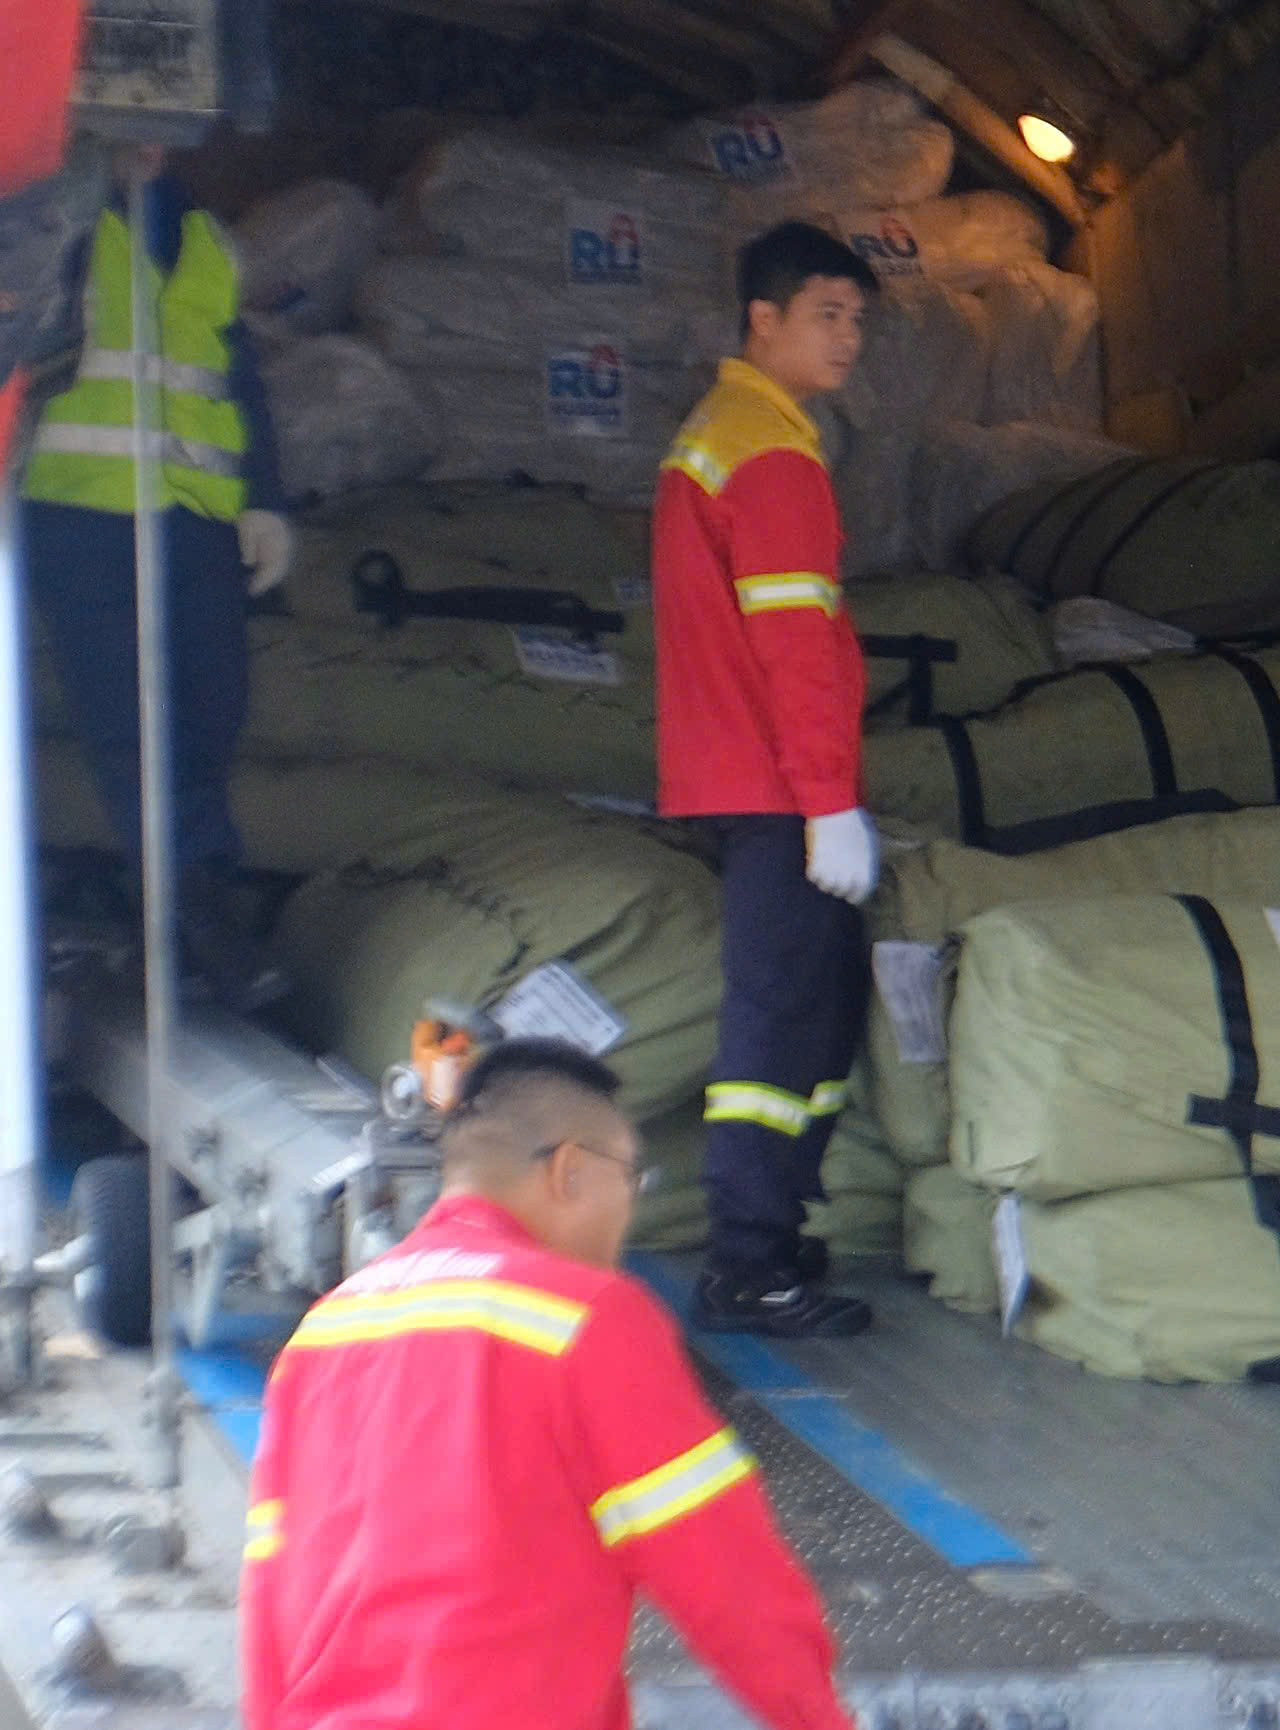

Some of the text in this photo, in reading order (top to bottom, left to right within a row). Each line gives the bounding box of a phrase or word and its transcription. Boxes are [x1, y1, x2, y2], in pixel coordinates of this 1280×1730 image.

[714, 128, 783, 171] RU
[571, 230, 641, 269] RU
[549, 359, 620, 398] RU
